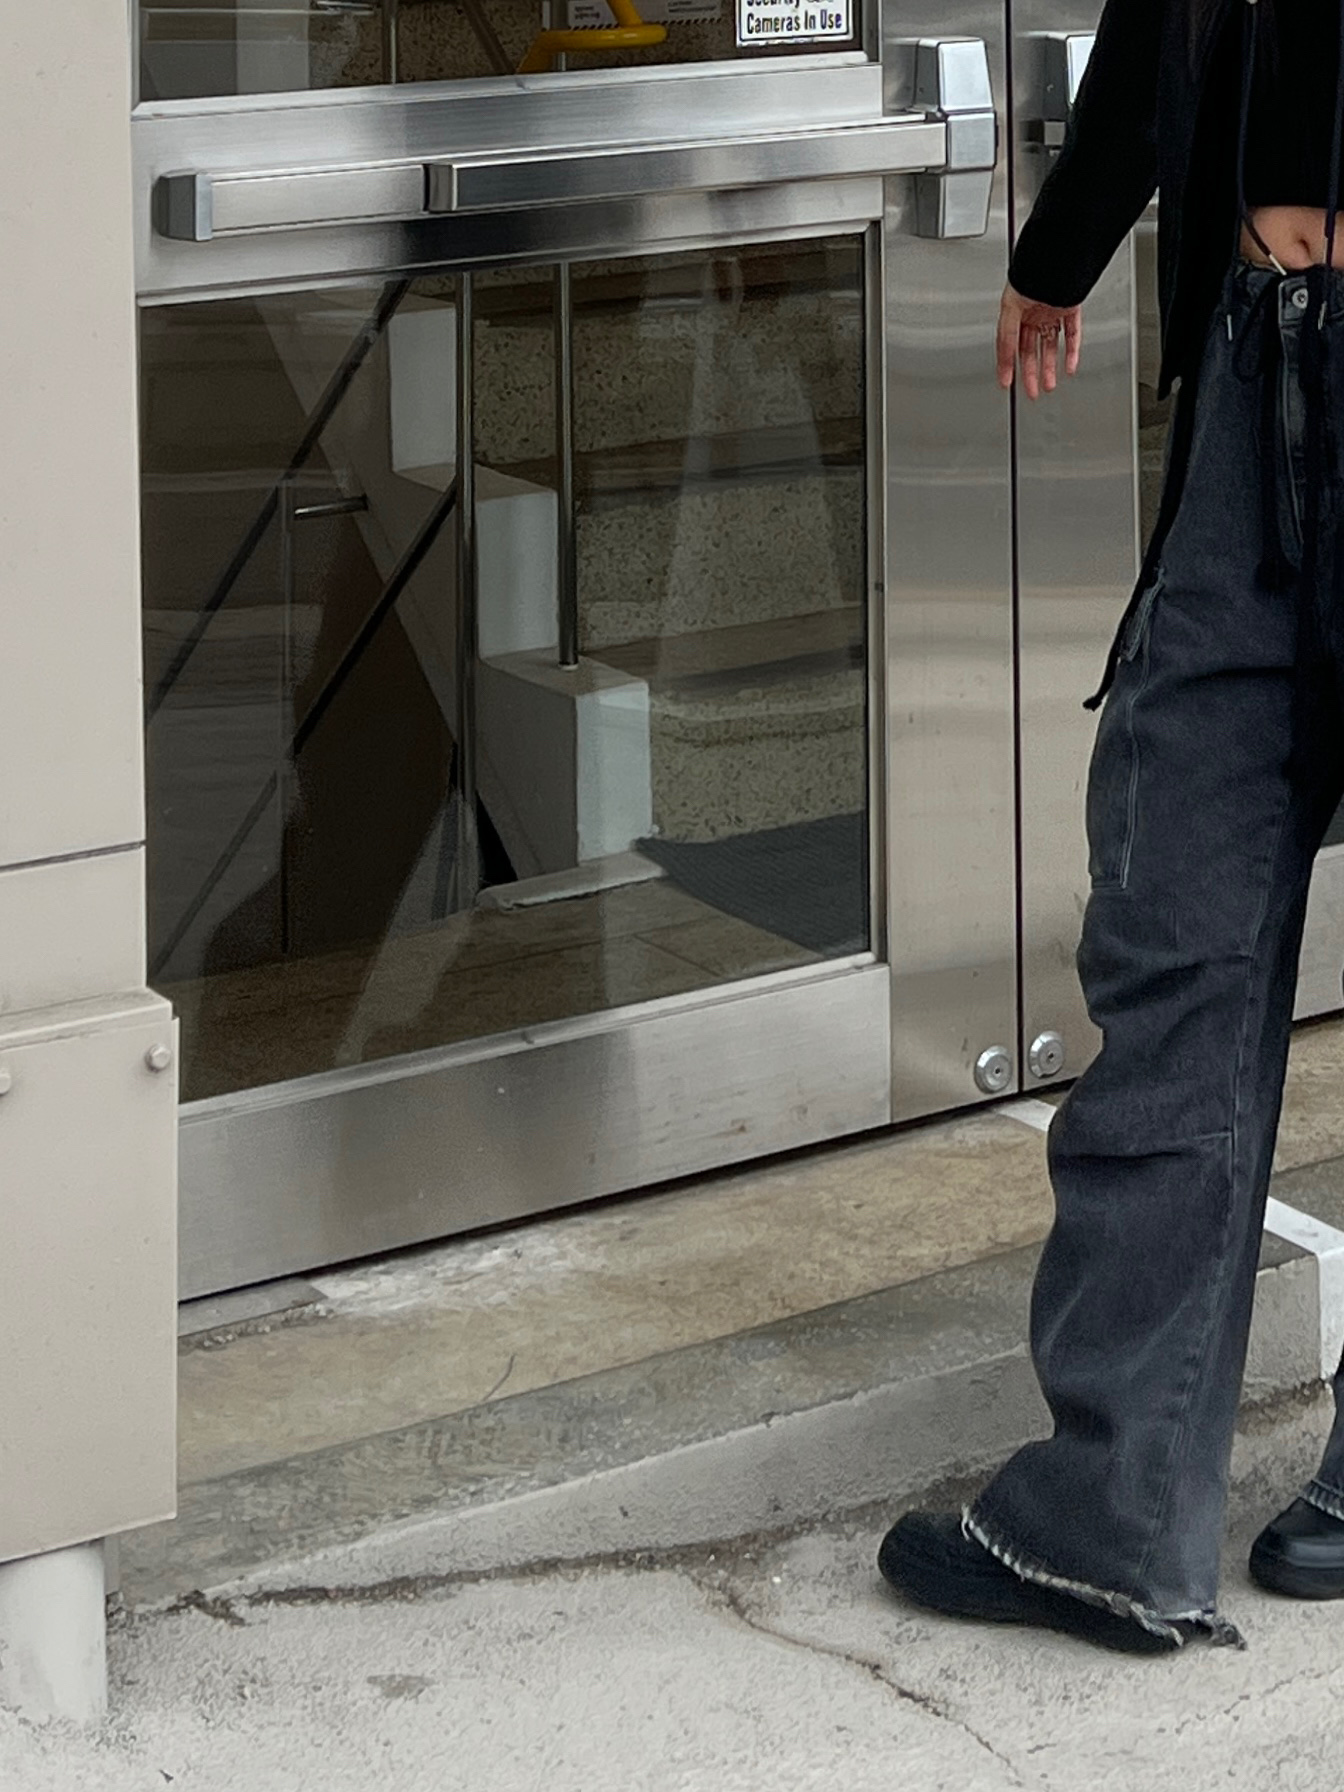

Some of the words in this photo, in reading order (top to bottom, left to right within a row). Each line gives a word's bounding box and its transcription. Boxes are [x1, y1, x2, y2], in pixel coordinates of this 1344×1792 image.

[747, 12, 800, 34] Cameras
[804, 10, 816, 30] In
[820, 9, 842, 30] Use
